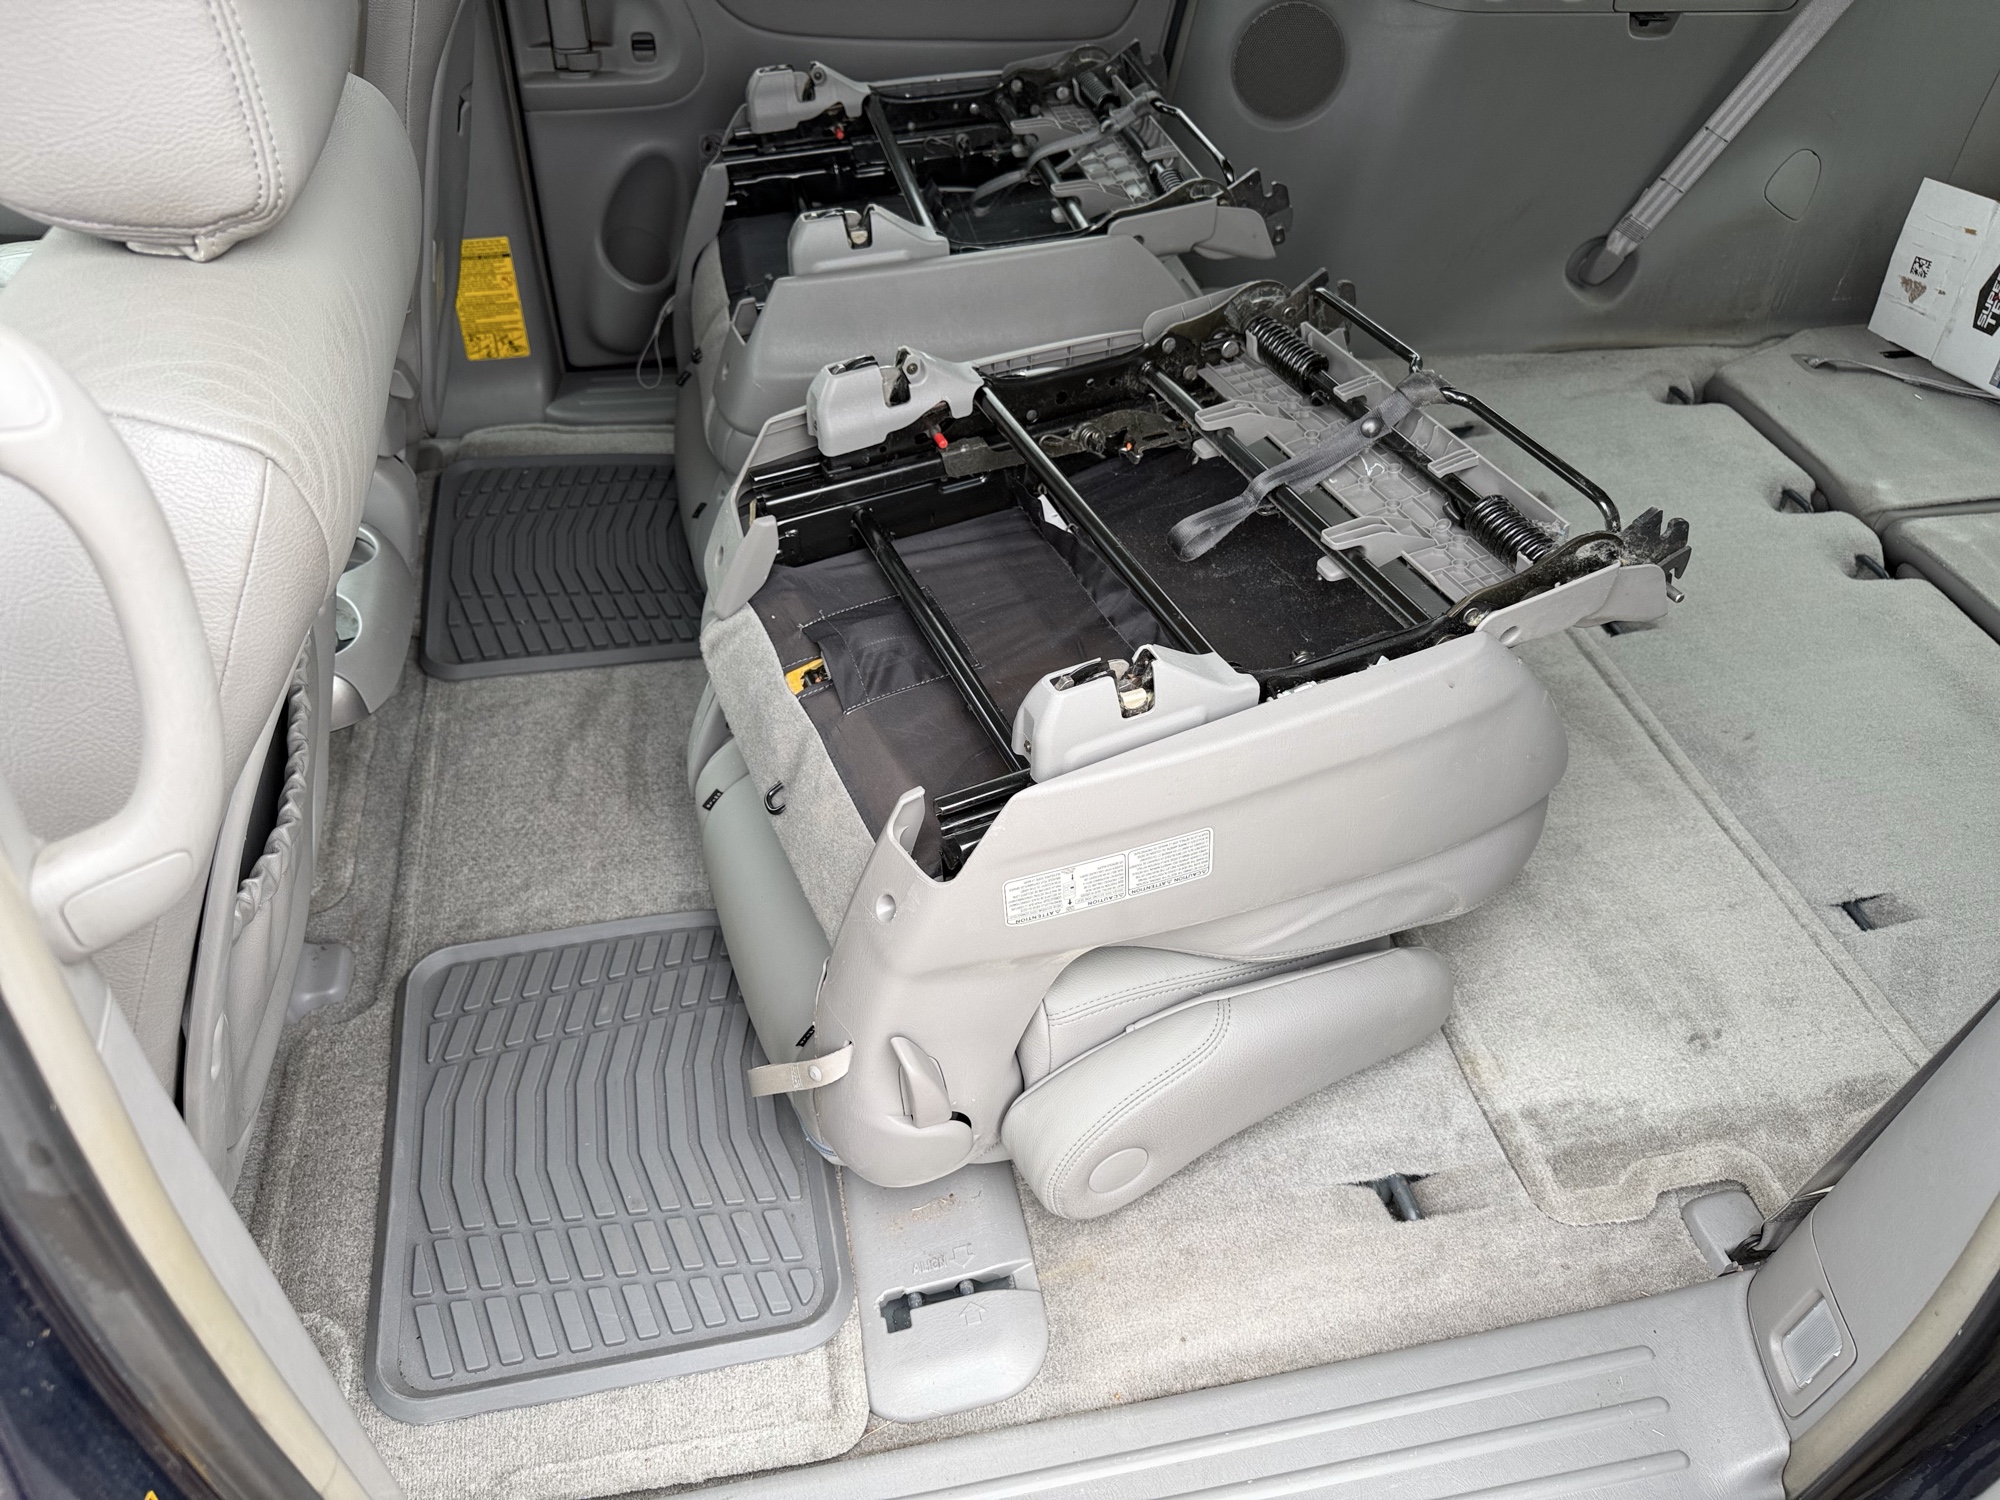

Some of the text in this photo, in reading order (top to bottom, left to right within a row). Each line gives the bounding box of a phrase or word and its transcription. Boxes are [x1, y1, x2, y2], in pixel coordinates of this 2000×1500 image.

[1977, 272, 2000, 327] SUPE
[1131, 871, 1202, 894] CAUTION ATTENTION
[1087, 894, 1119, 906] CAUTION
[1015, 910, 1055, 924] ATTENTION
[912, 1254, 948, 1275] ALIGN
